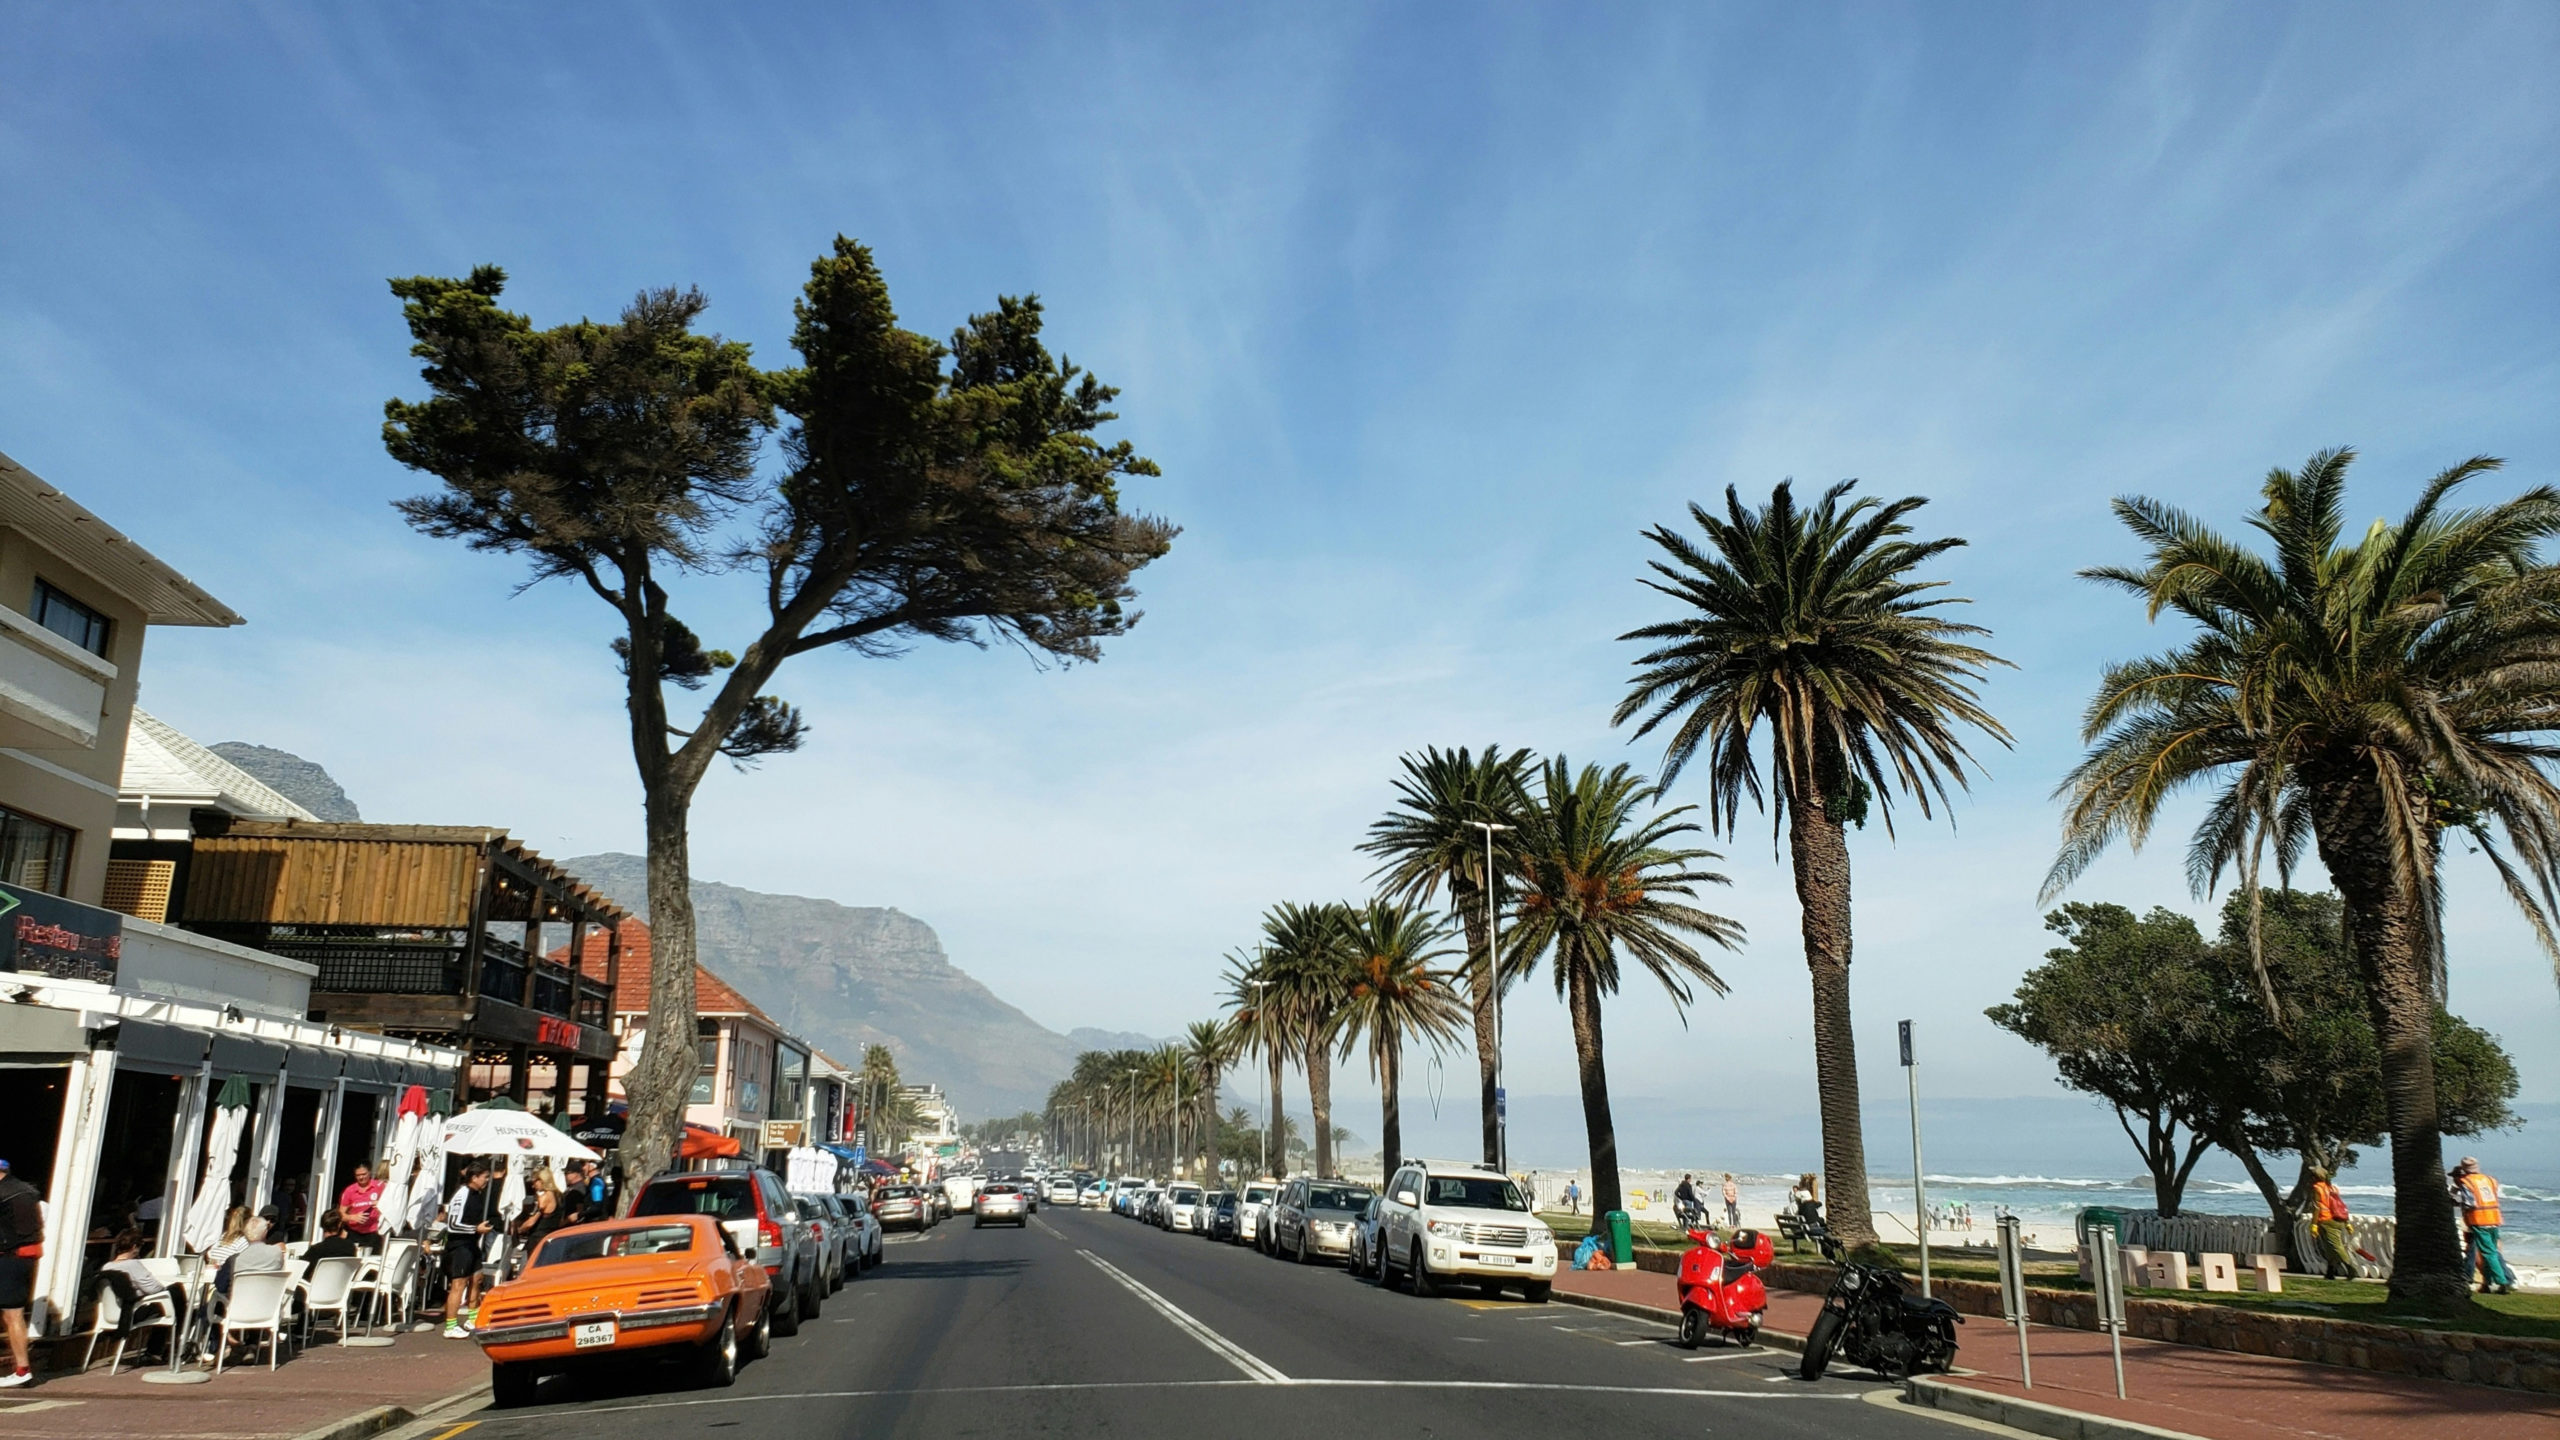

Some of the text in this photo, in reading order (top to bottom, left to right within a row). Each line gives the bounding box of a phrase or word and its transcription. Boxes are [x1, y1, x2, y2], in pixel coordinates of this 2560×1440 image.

[575, 1130, 620, 1141] Corona
[856, 1130, 866, 1147] AUAI
[588, 1324, 602, 1334] CA
[577, 1334, 613, 1345] 298367
